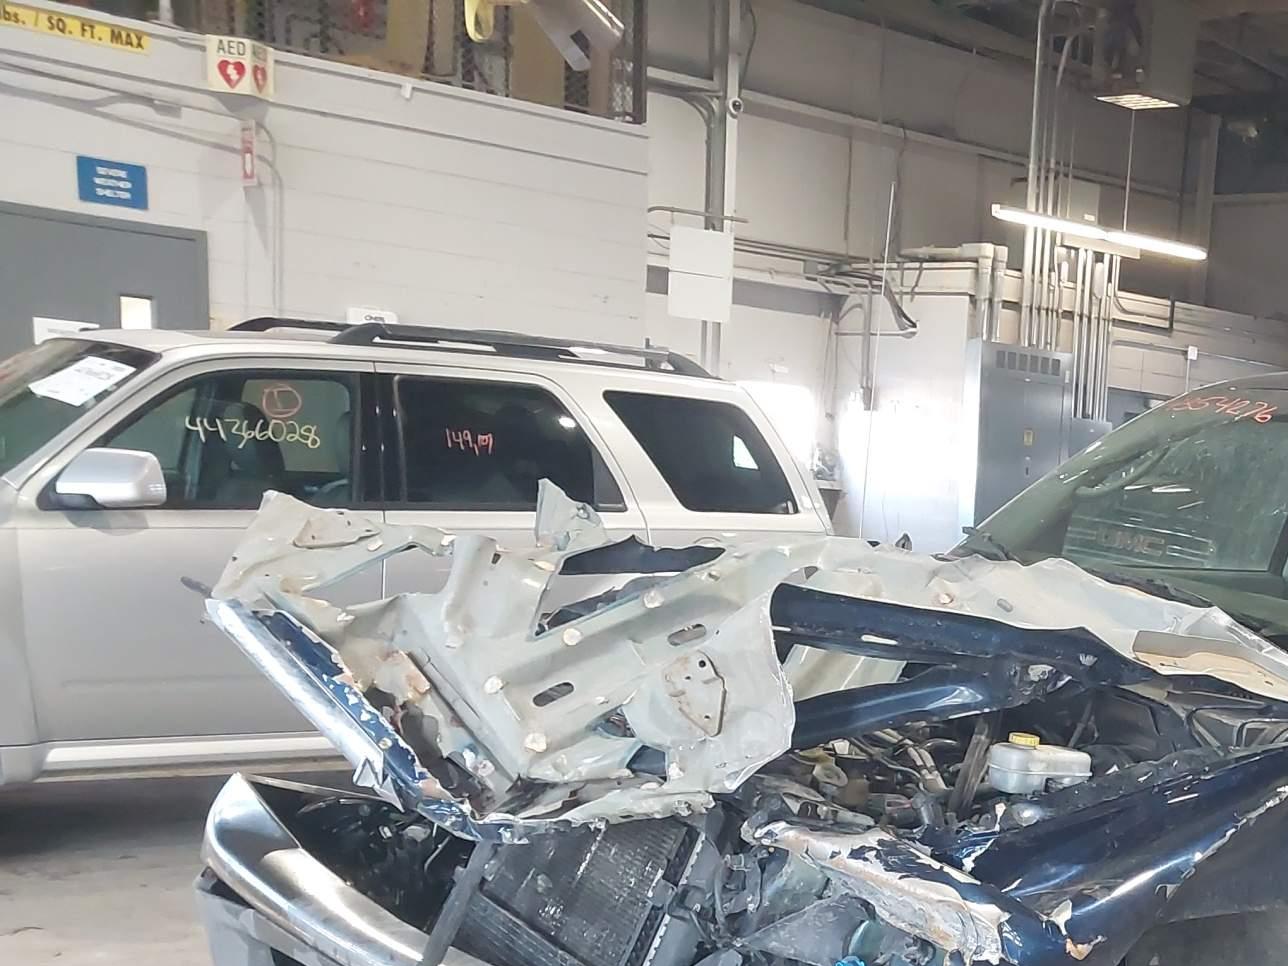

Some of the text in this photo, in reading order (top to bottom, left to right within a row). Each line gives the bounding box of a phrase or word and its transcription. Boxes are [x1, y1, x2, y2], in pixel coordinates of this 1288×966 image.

[47, 15, 73, 35] SQ.
[81, 22, 103, 41] FT.
[110, 29, 144, 50] MAX
[217, 39, 246, 56] AED
